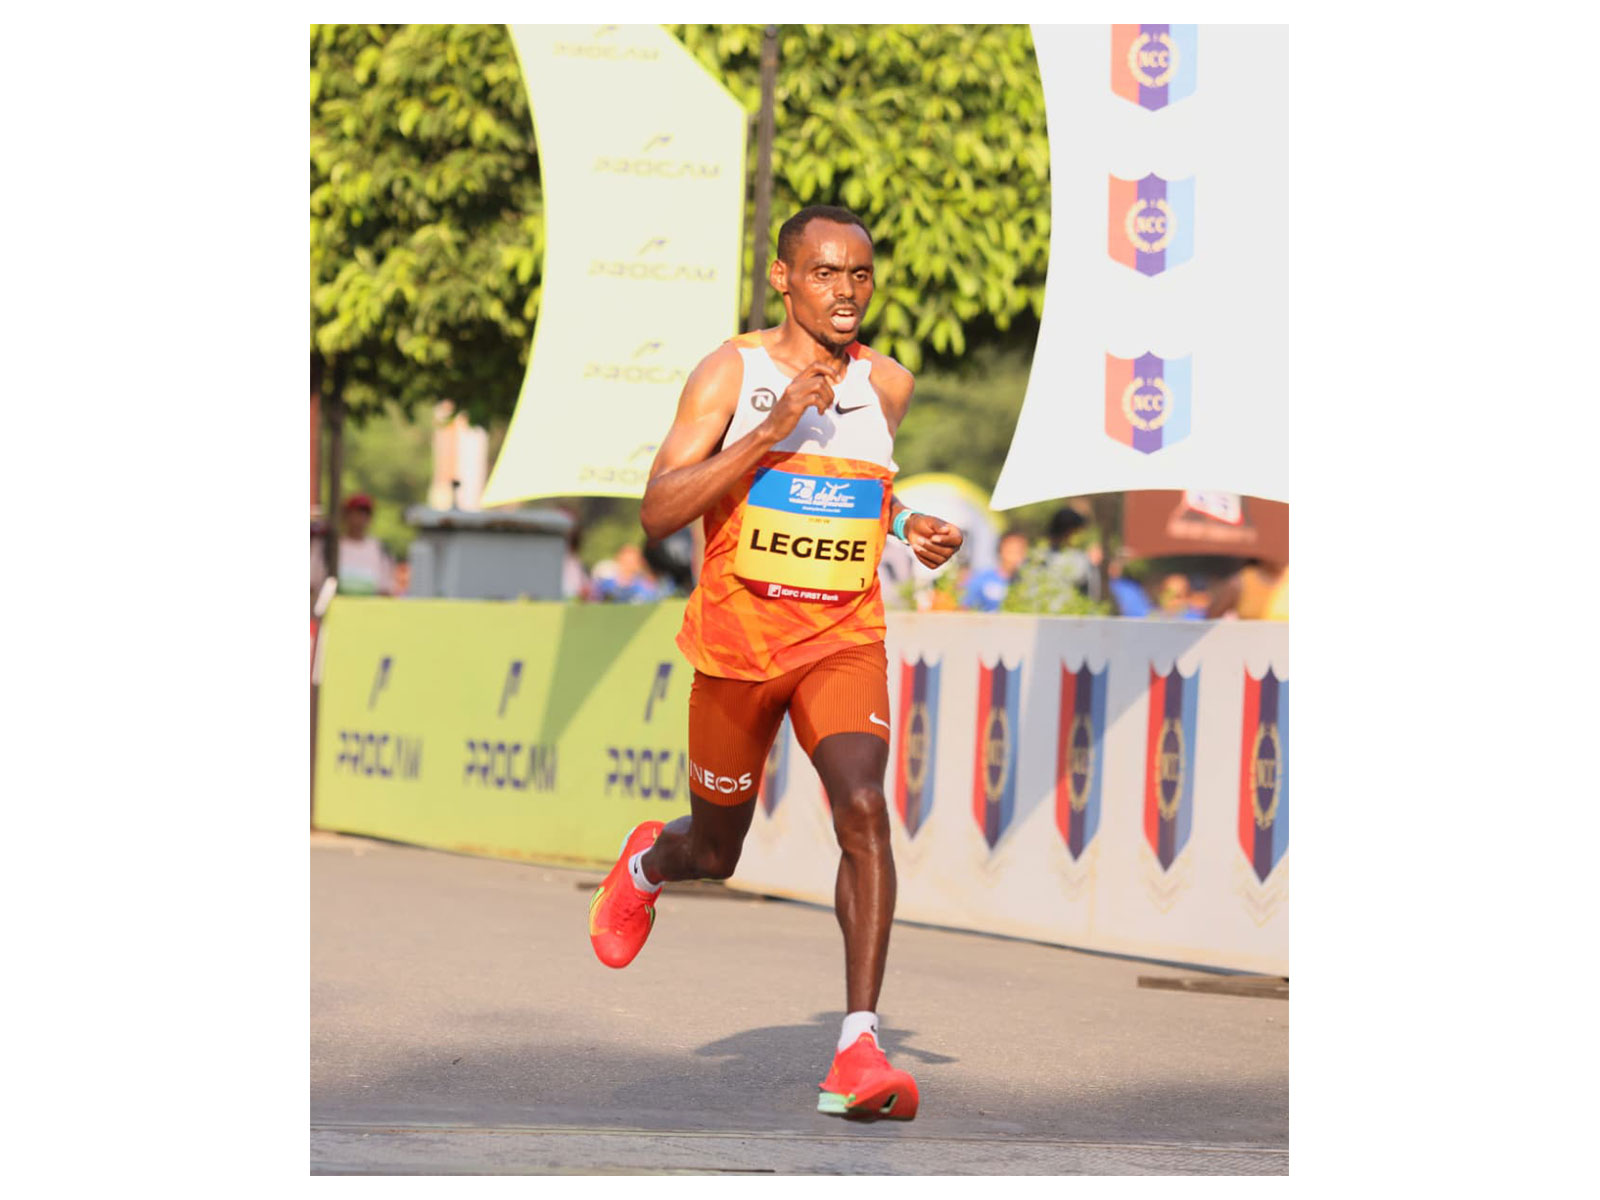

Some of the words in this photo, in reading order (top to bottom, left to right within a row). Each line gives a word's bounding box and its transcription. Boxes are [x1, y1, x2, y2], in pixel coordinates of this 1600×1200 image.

[1138, 49, 1169, 68] NCC
[592, 156, 721, 178] PROCAM
[1136, 215, 1166, 234] NCC
[587, 259, 718, 281] PROCAM
[583, 362, 687, 384] PROCA
[1133, 393, 1164, 412] NCC
[750, 529, 867, 562] LEGESE
[859, 577, 866, 589] 1
[800, 591, 821, 600] FIRST
[822, 593, 839, 601] Bank
[604, 747, 689, 801] PROCA
[689, 759, 753, 794] INEOS
